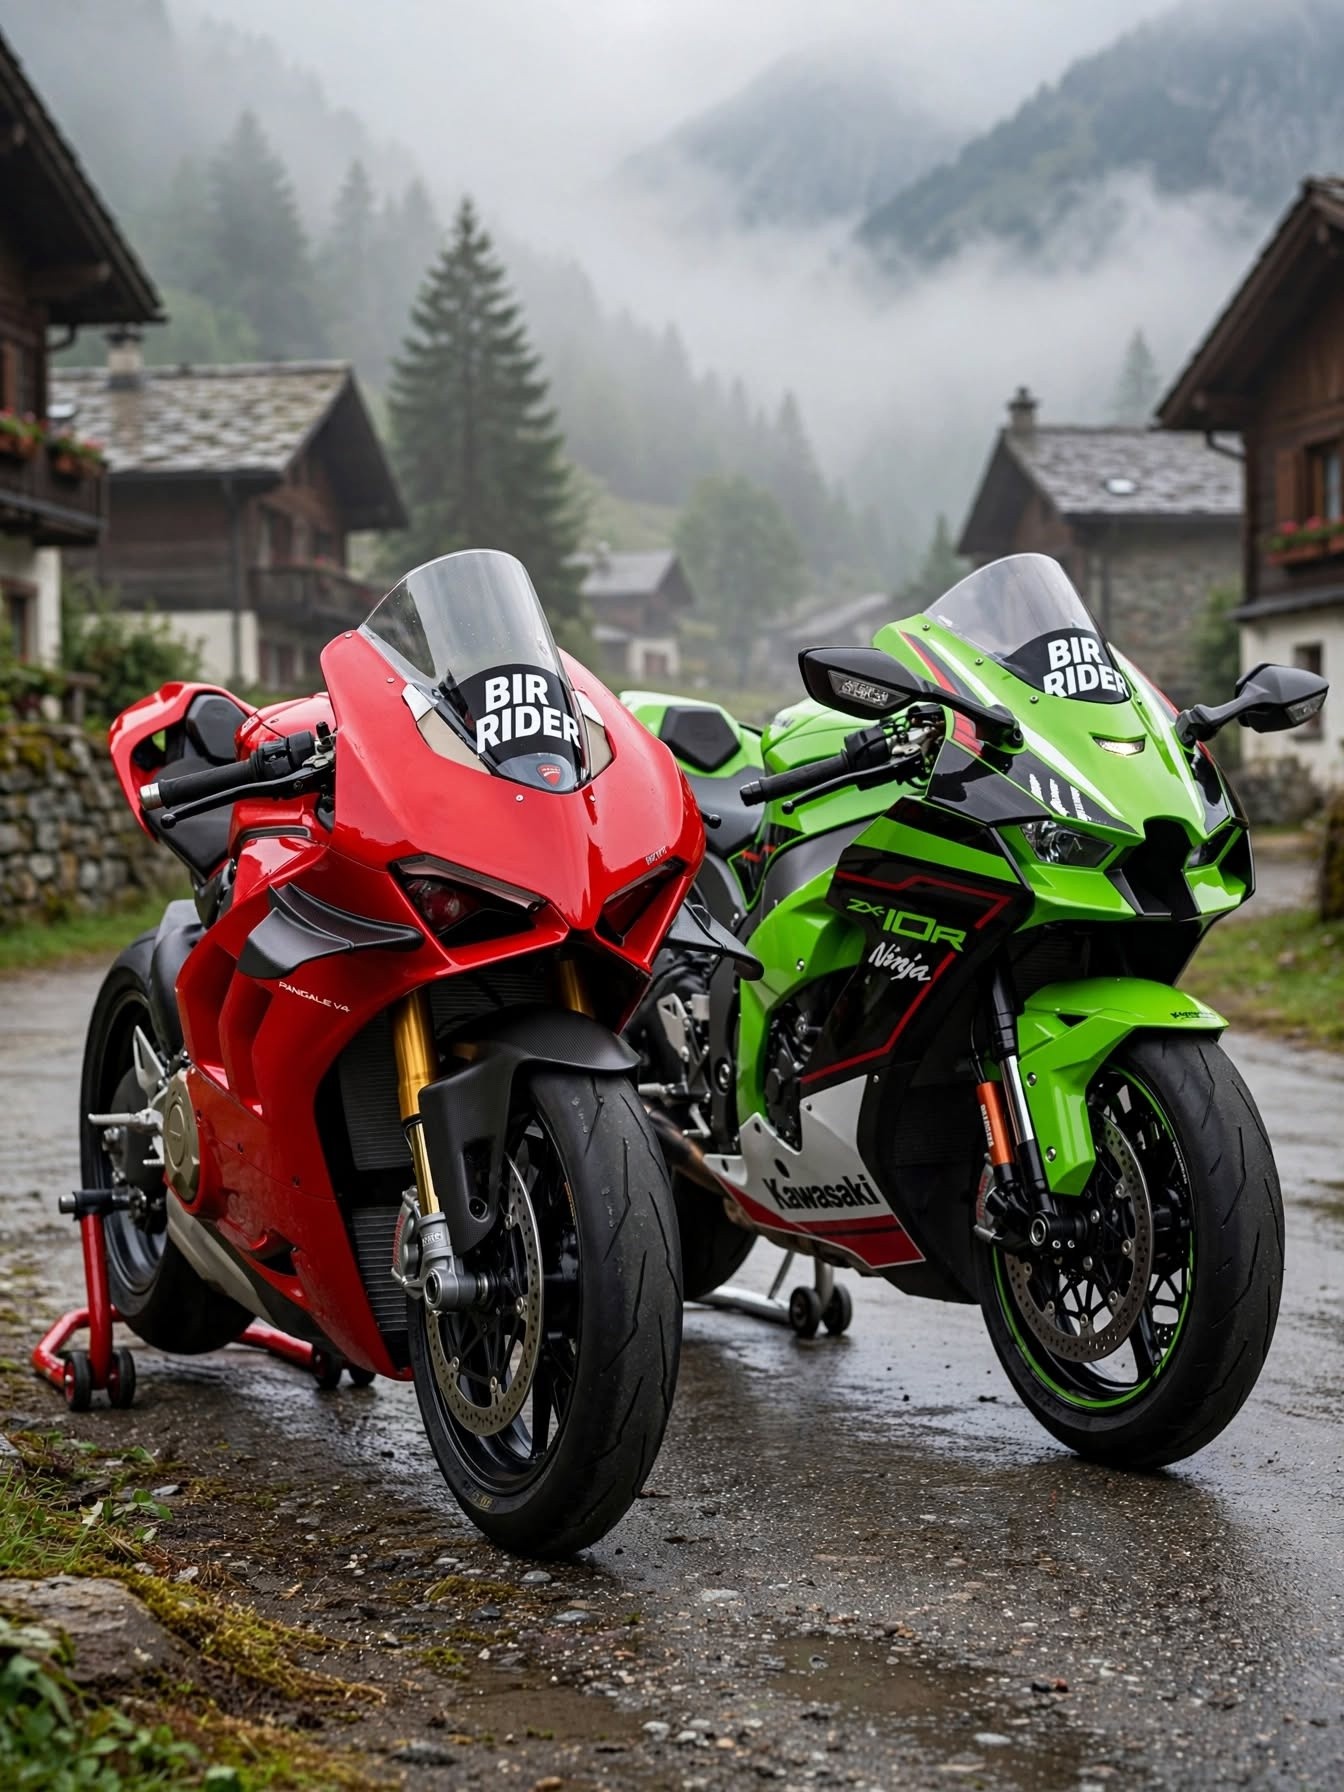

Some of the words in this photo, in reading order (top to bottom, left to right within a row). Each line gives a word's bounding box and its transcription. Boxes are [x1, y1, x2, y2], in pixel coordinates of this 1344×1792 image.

[1047, 637, 1103, 671] BIR
[485, 673, 549, 713] BIR
[1042, 664, 1129, 698] RIDER
[475, 705, 581, 754] RIDER
[846, 898, 967, 952] ZX-10R
[868, 941, 931, 981] Ninja
[333, 1002, 351, 1013] V4
[762, 1174, 881, 1210] Kawasaki
